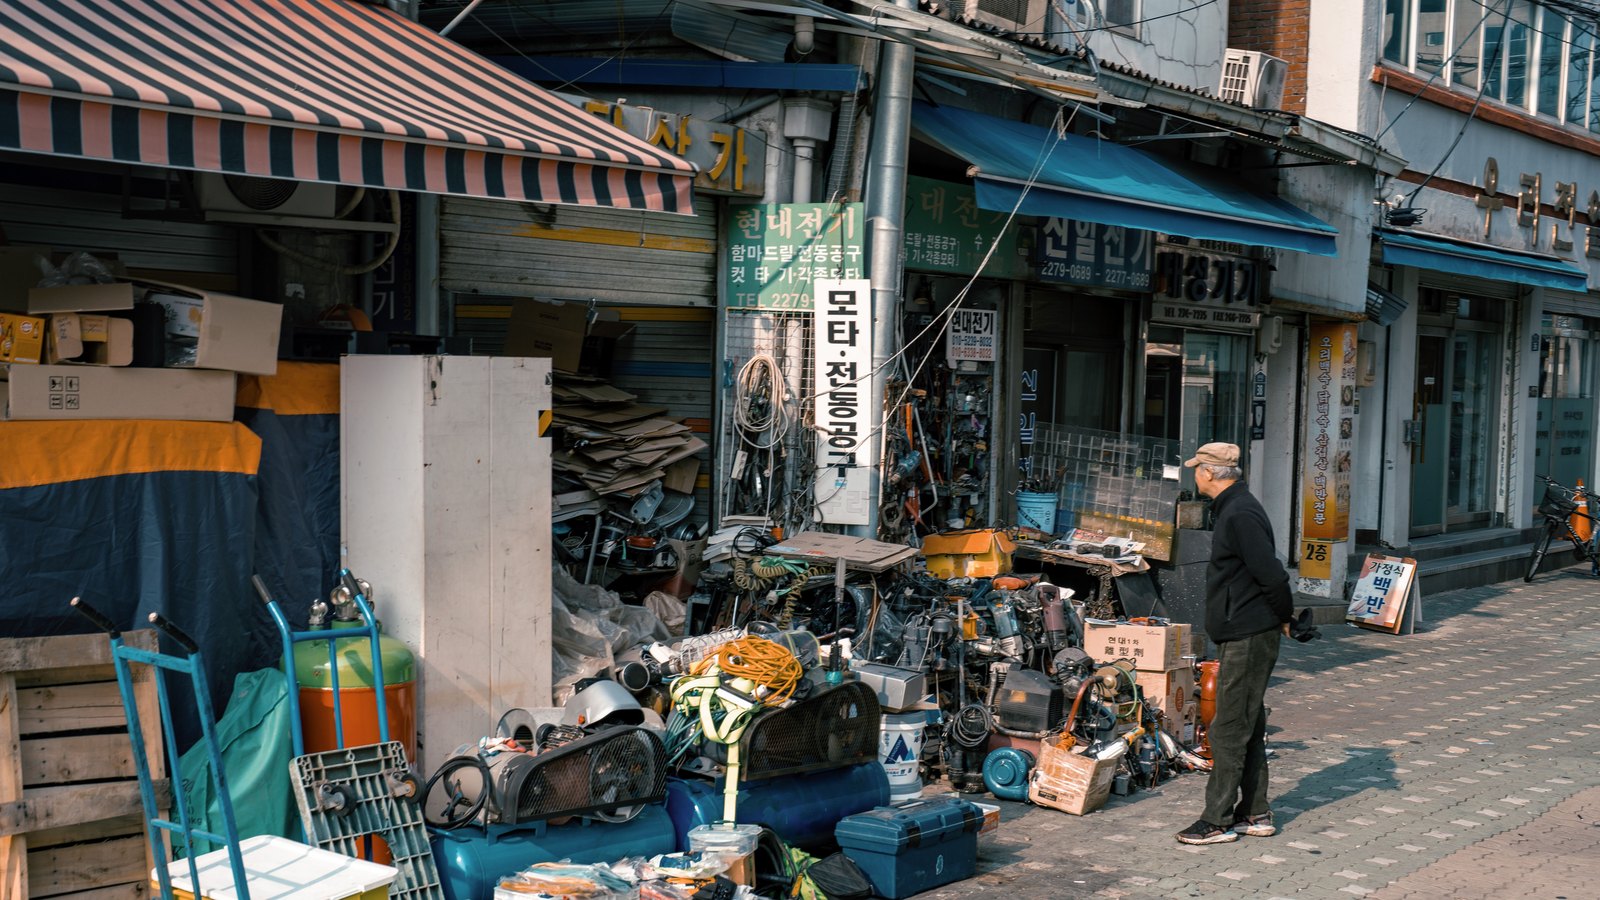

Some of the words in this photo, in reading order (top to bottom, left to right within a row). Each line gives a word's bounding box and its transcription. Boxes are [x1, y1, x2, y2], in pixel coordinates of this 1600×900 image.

[735, 206, 856, 240] 현대전기
[1043, 216, 1152, 271] 신일전기
[1041, 262, 1091, 280] 2279-0689
[1105, 269, 1150, 287] 2277-0689
[735, 292, 766, 308] TEL
[951, 311, 994, 335] 현대전기
[826, 290, 859, 478] 모타·전동공구
[1305, 543, 1328, 561] 2층
[1369, 562, 1406, 577] 가정식
[1366, 576, 1392, 615] 백반
